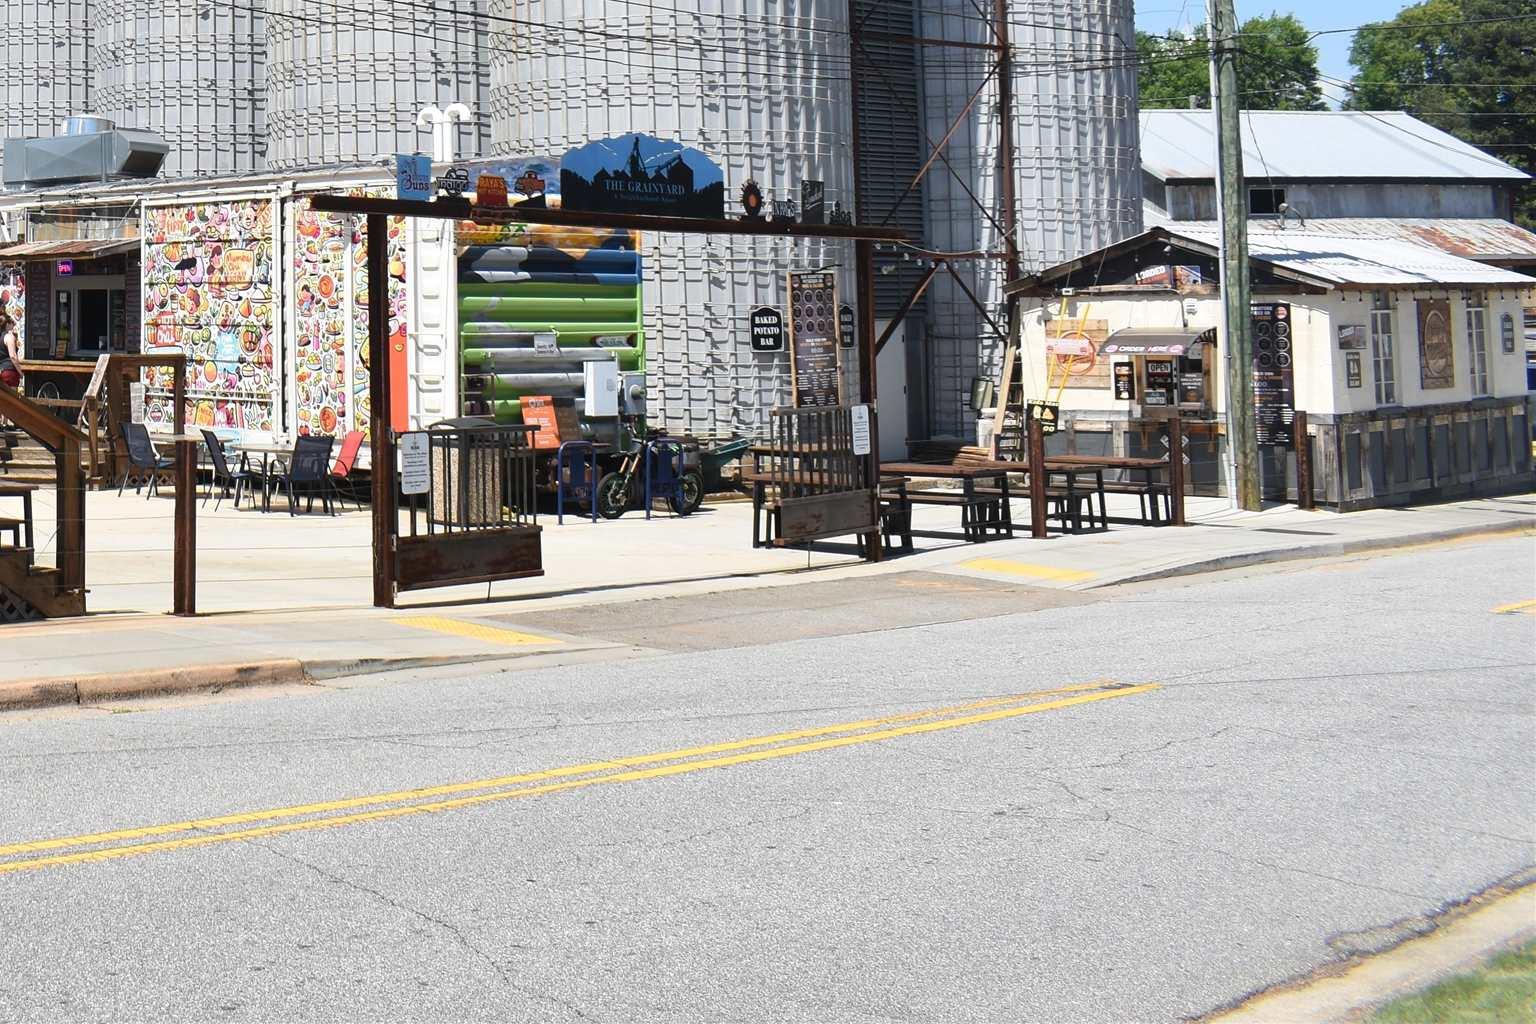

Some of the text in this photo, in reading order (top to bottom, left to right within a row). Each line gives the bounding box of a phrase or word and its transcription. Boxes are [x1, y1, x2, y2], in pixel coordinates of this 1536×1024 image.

[604, 180, 686, 195] THE GRAINYARD
[754, 316, 778, 324] BAKED
[753, 327, 780, 335] POTATO
[760, 338, 775, 346] BAR
[1151, 364, 1169, 372] OPEN
